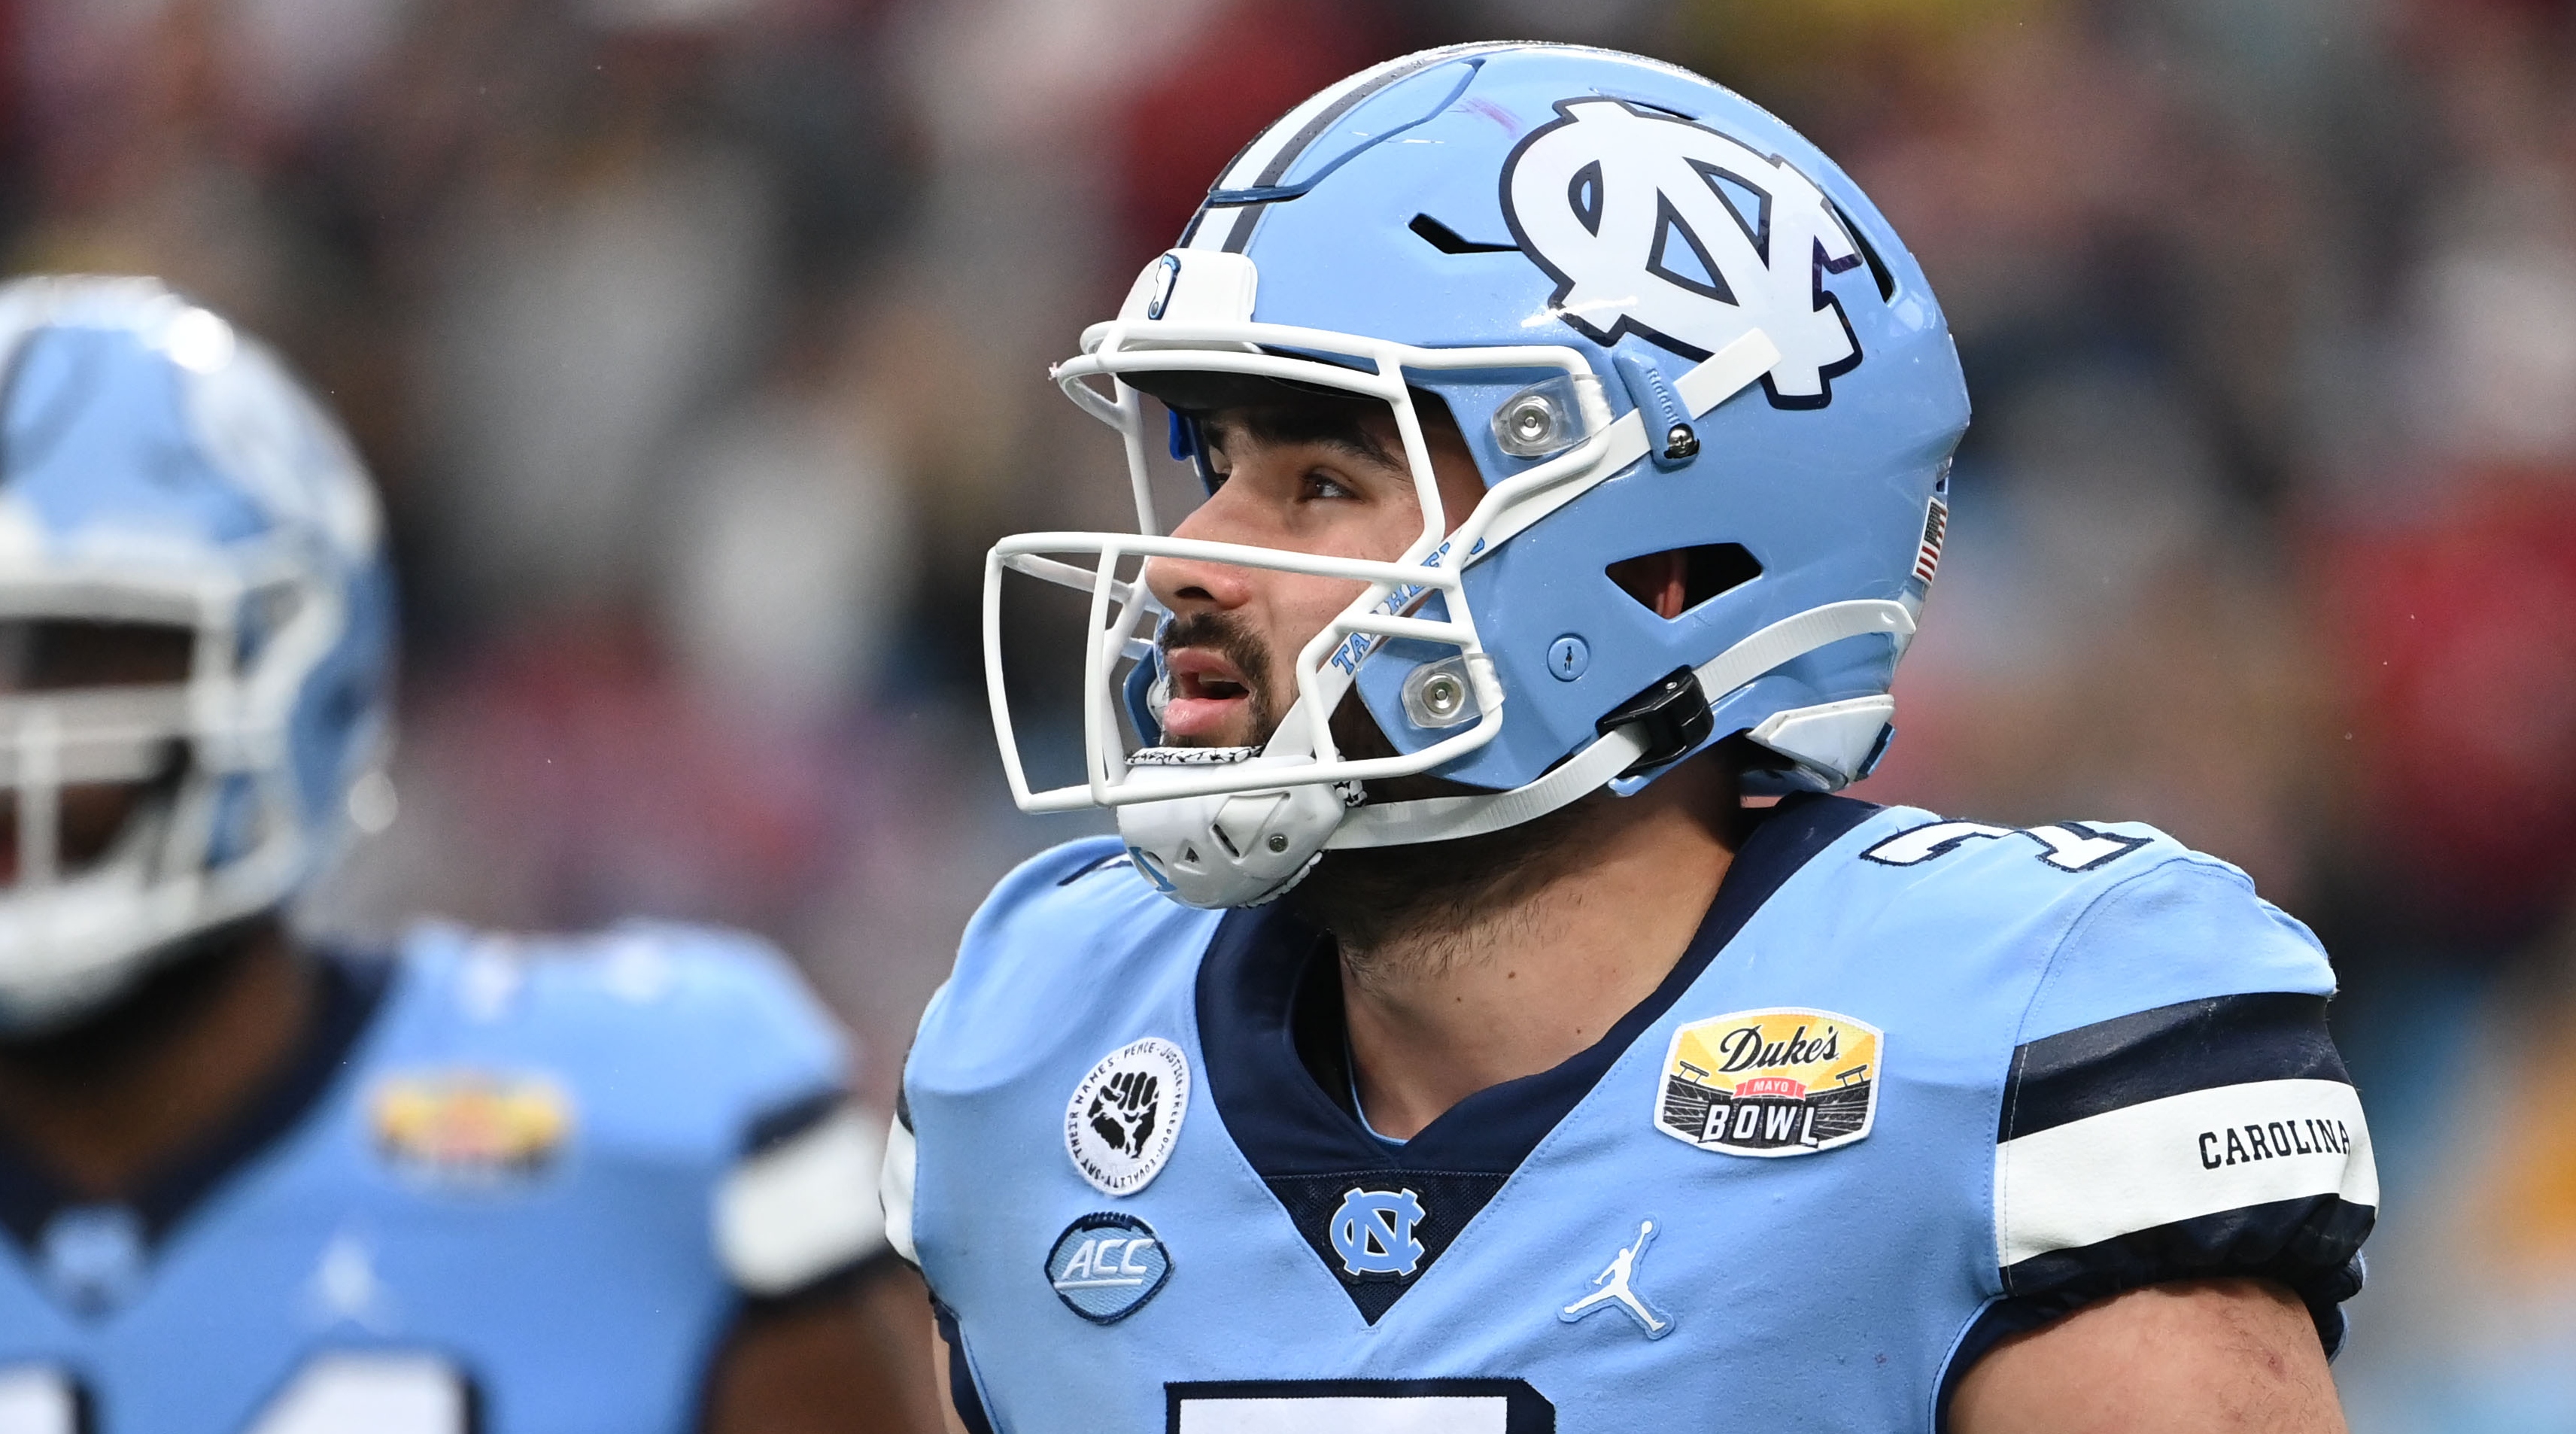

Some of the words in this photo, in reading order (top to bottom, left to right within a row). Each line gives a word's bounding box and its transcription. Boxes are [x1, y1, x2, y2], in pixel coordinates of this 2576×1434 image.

[1124, 1041, 1156, 1059] PEACE
[1718, 1024, 1840, 1073] Duke's
[1074, 1056, 1114, 1105] NAMES
[1753, 1080, 1789, 1092] MAYO
[1068, 1110, 1083, 1159] THEIR
[1702, 1104, 1819, 1146] BOWL
[2198, 1119, 2350, 1170] CAROLINA
[1080, 1158, 1103, 1180] SAY
[1061, 1238, 1156, 1279] ACC
